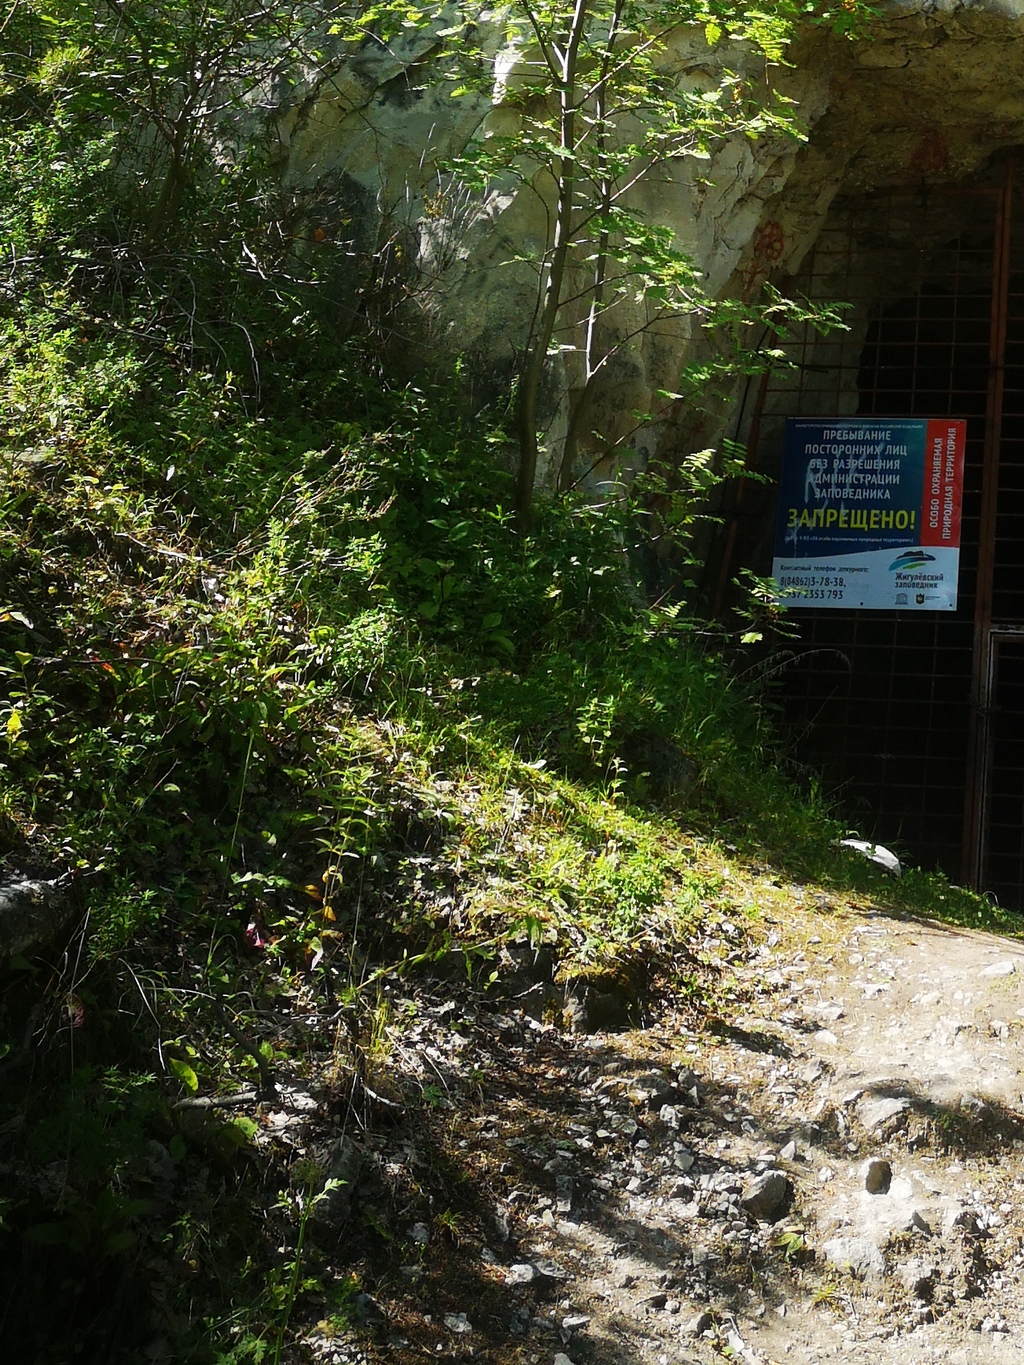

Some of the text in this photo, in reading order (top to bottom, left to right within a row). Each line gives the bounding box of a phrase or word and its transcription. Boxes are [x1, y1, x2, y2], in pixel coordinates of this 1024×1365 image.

[823, 430, 891, 440] ПРЕБЫВАНИЕ
[805, 444, 908, 456] ПОСТОРОННИХ ЛИЦ
[810, 458, 900, 470] БЕЗ РАЗРЕШЕНИЯ
[929, 437, 943, 528] ОСОБО ОХРАНЯЕМАЯ
[942, 427, 957, 539] ПРИРОДНАЯ ТЕРРИТОРИЯ
[814, 488, 891, 499] ЗАПОВЕДНИКА
[787, 508, 916, 531] ЗАПРЕЩЕНО!
[827, 590, 843, 600] 793
